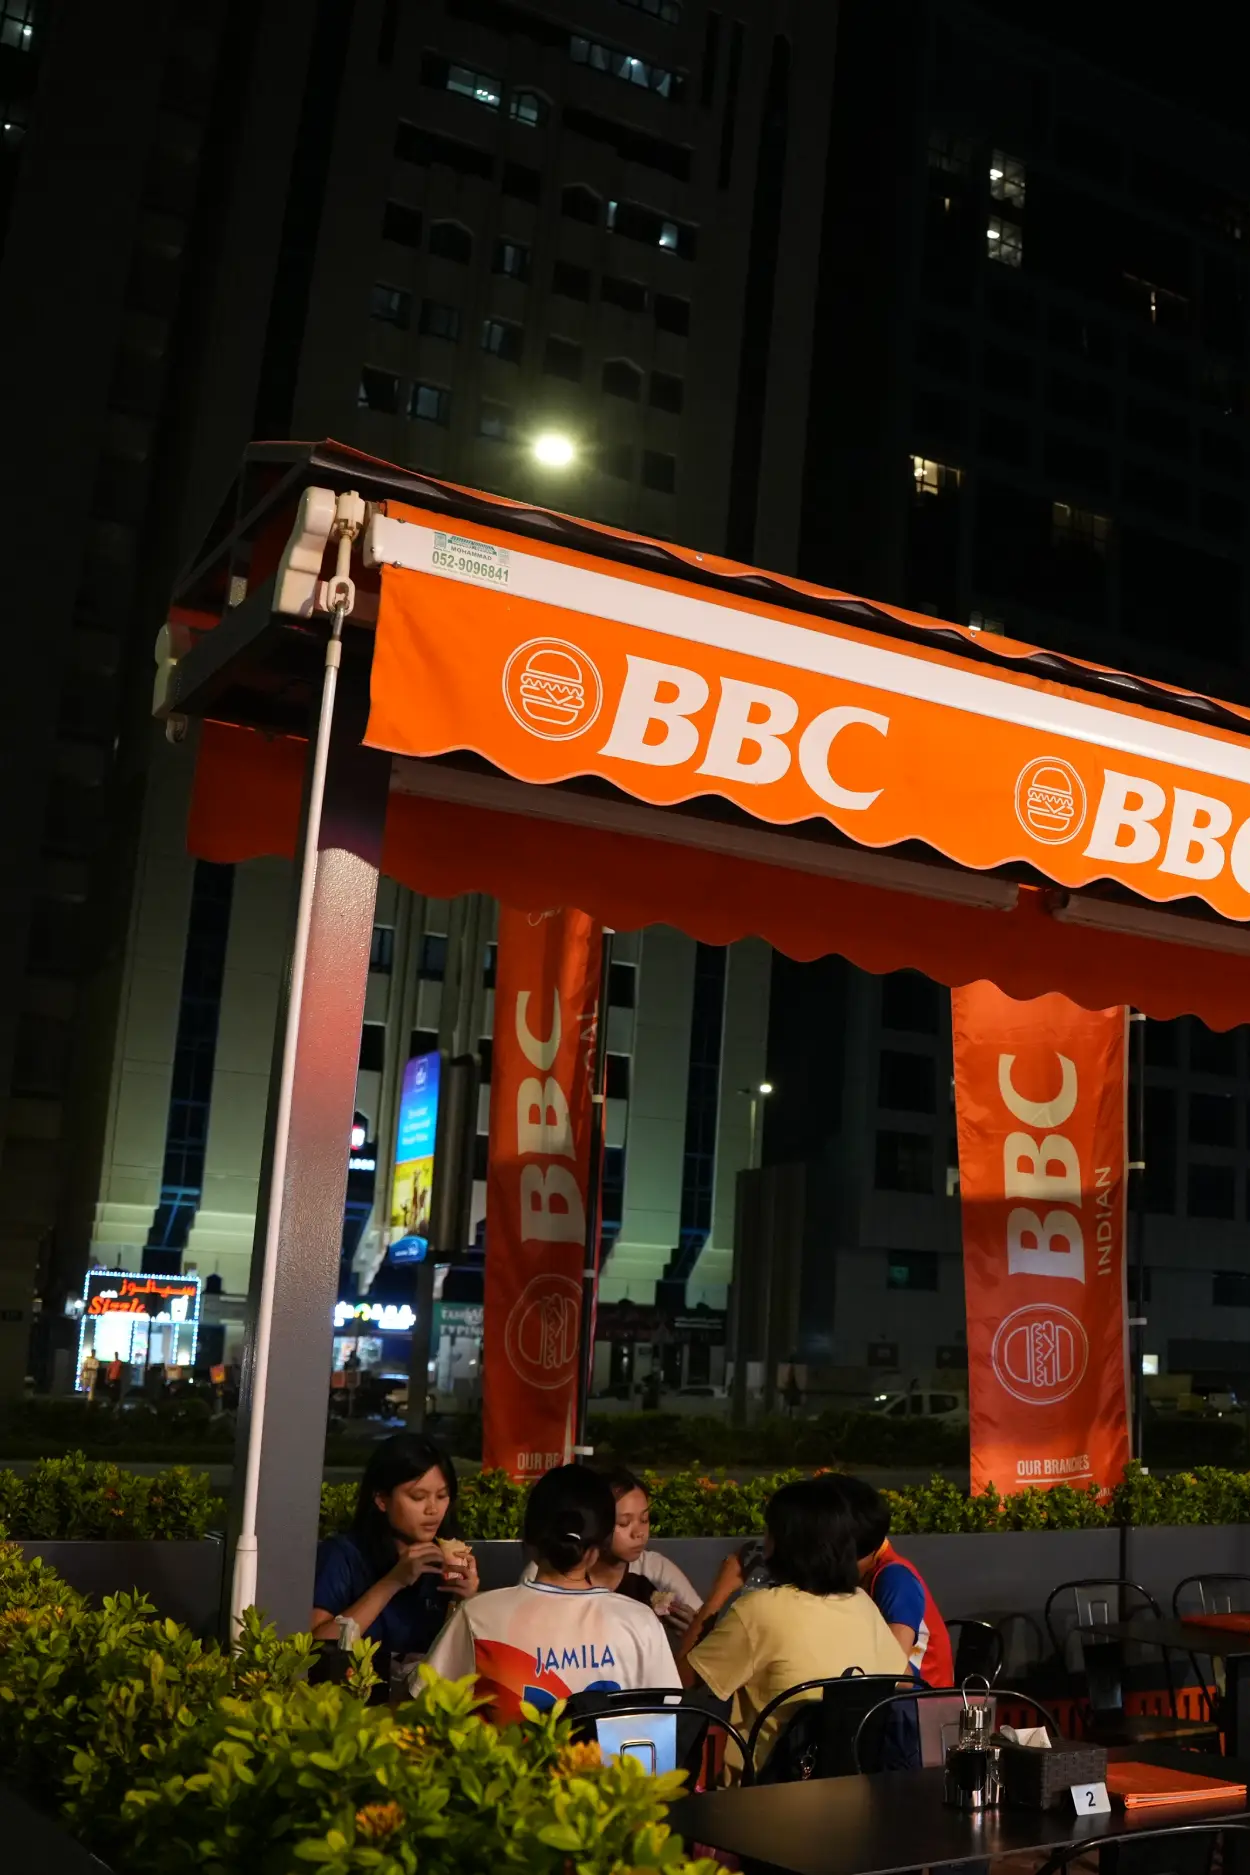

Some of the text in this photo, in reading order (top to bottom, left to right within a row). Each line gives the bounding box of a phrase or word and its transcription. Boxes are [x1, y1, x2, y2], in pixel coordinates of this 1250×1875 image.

[432, 550, 509, 582] 052-9096841
[450, 546, 492, 561] MOHAMMAD
[597, 654, 891, 811] BBC
[516, 987, 586, 1248] BBC
[998, 1053, 1087, 1286] BBC
[1094, 1166, 1113, 1276] INDIAN
[517, 1452, 543, 1470] OUR
[1016, 1459, 1042, 1476] OUR
[535, 1644, 616, 1676] JAMILA
[1085, 1790, 1097, 1808] 2
